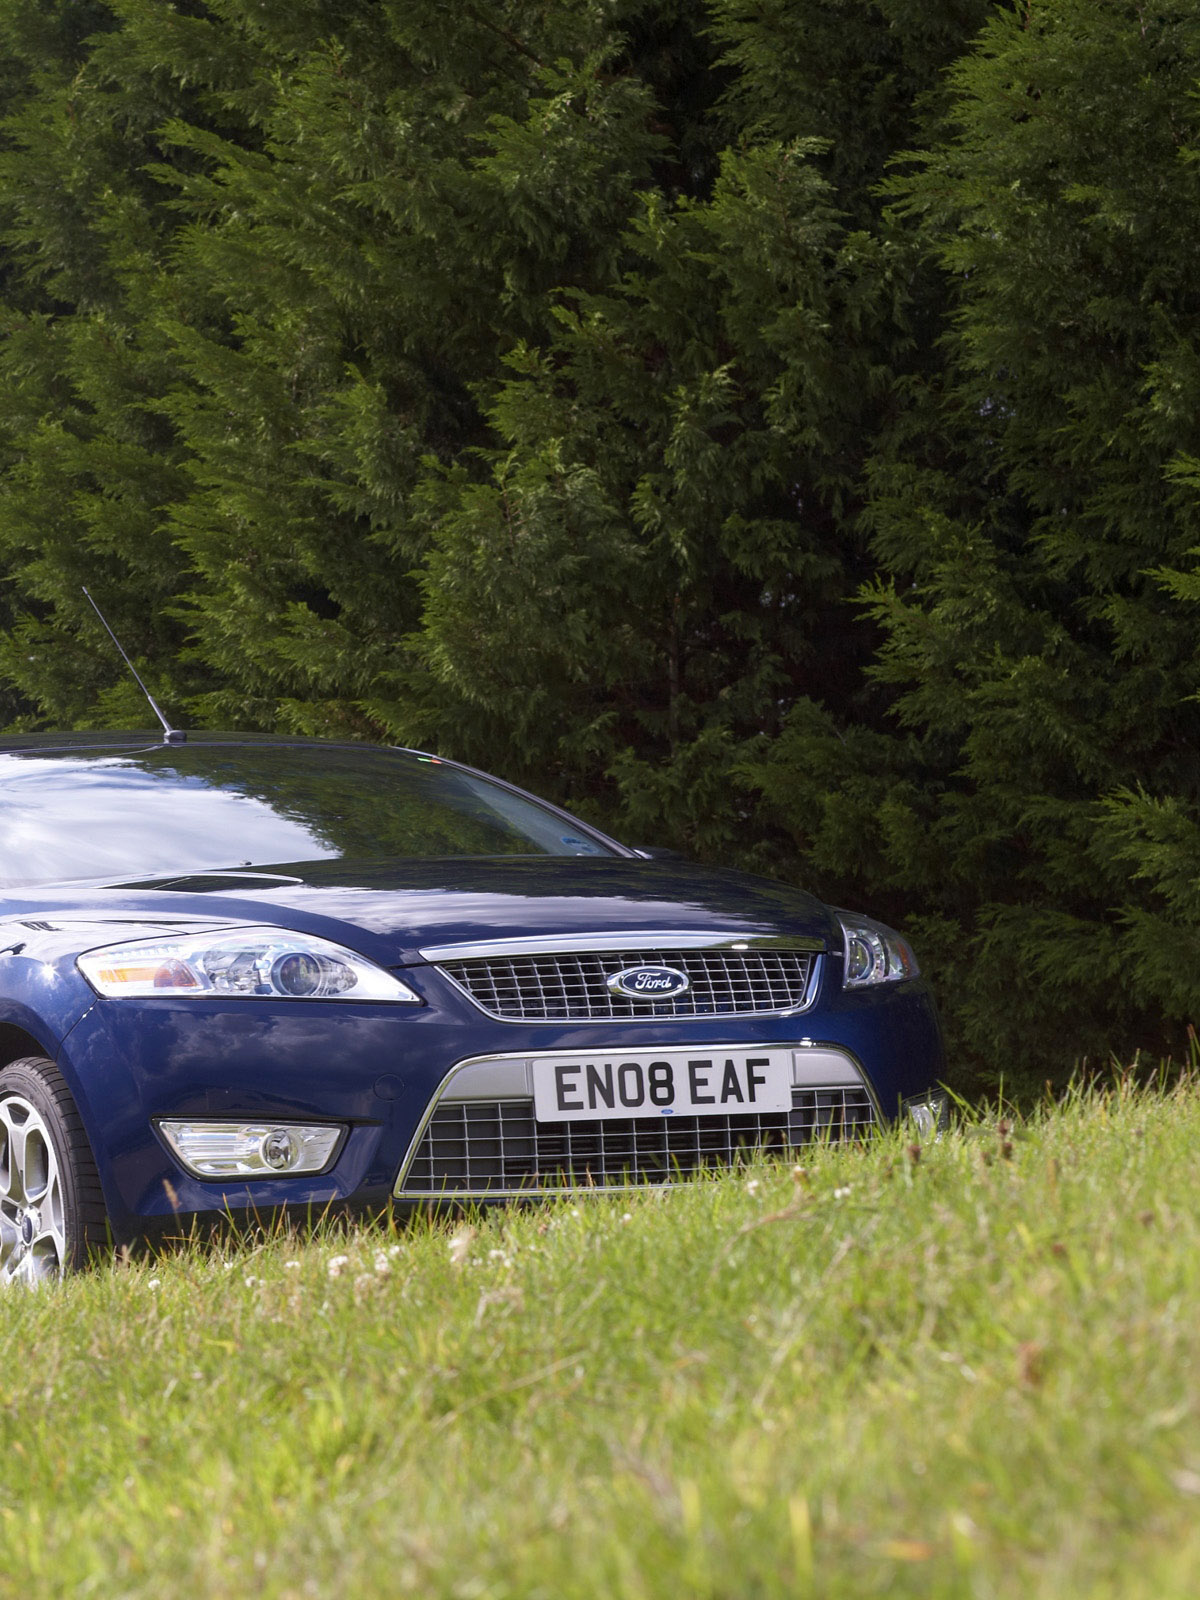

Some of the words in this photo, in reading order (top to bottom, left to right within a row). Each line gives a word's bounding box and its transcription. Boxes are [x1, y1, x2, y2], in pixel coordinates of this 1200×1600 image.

[635, 972, 672, 989] Ford
[554, 1061, 675, 1111] EN08
[688, 1058, 770, 1105] EAF
